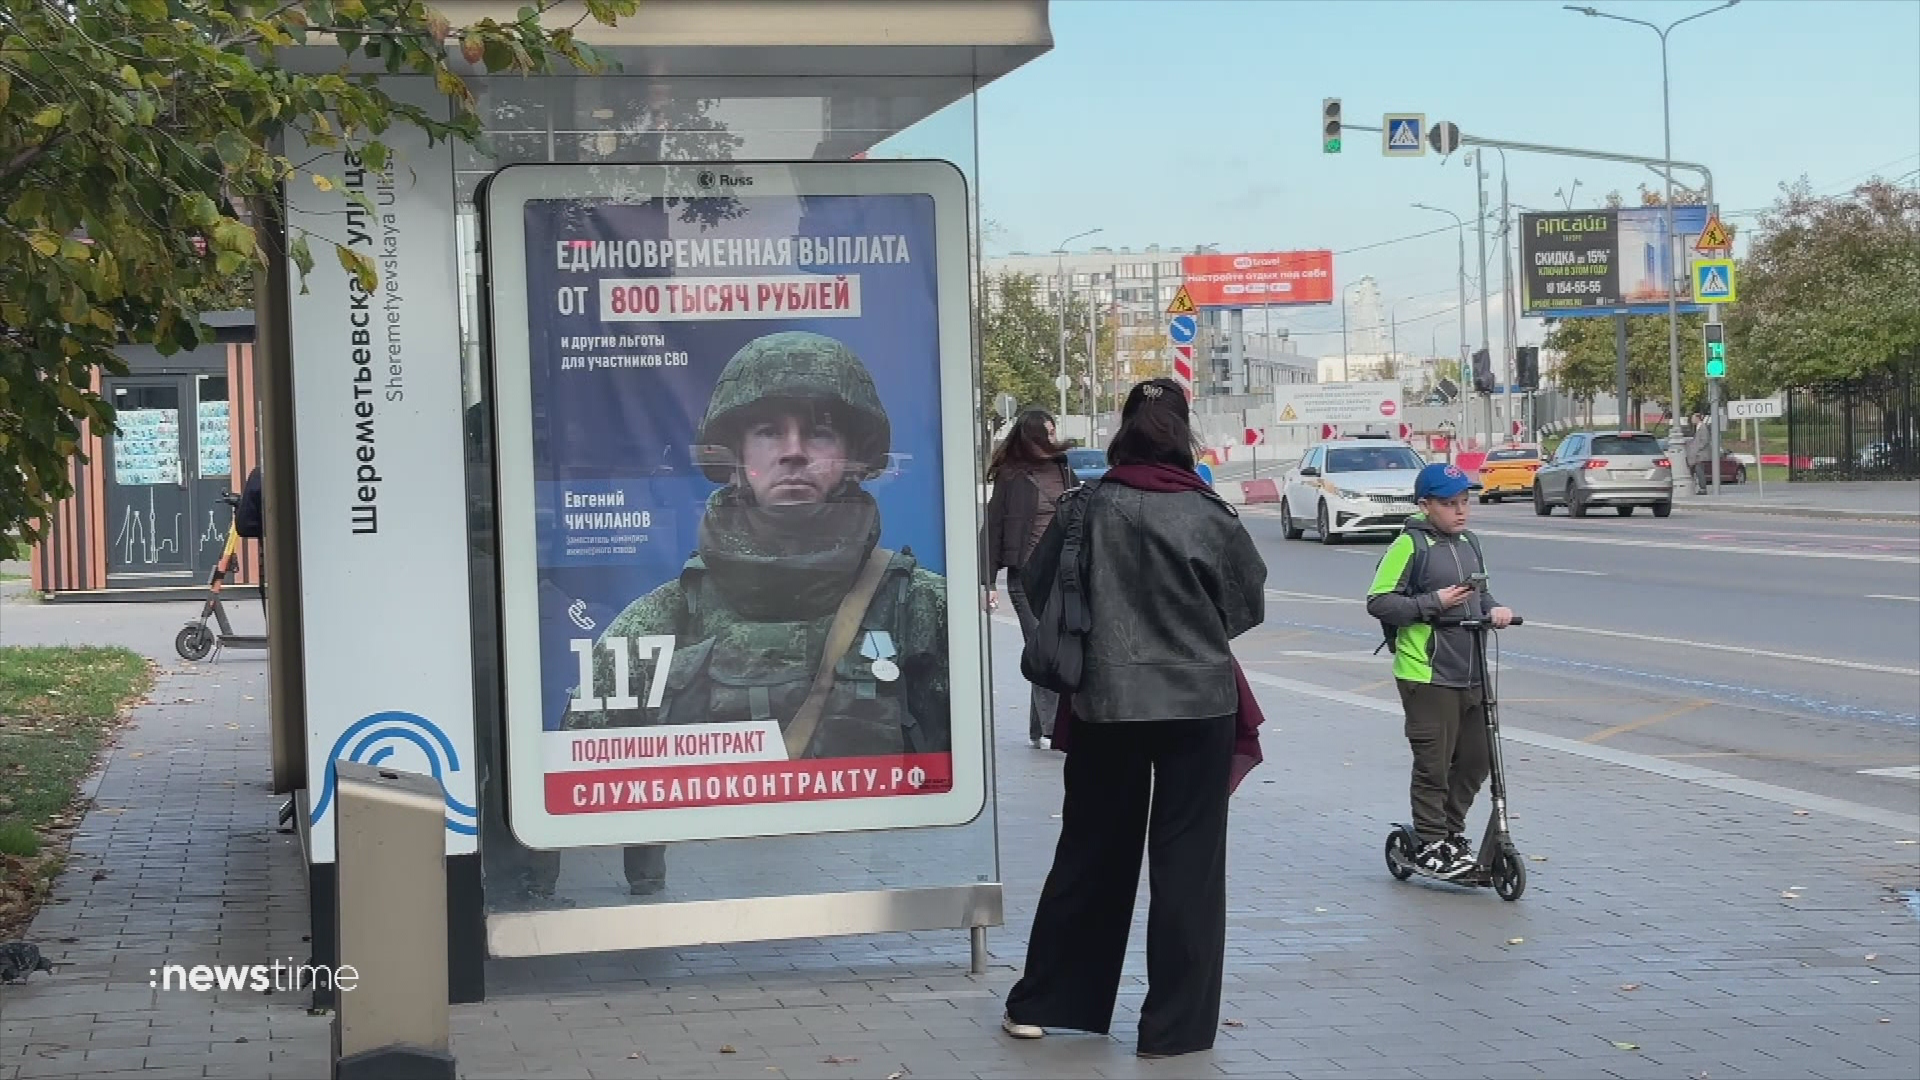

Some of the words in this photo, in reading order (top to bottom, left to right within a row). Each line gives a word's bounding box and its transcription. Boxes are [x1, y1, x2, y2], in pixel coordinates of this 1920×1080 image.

[720, 174, 753, 186] Russ
[556, 238, 792, 272] ЕДИНОВРЕМЕННАЯ
[799, 235, 910, 266] ВЫПЛАТА
[1535, 250, 1575, 266] СКИДКА
[1246, 272, 1278, 281] отдых
[1302, 269, 1327, 278] себя
[1571, 265, 1589, 275] ЭТОМ
[1590, 264, 1608, 274] ГОДУ
[557, 286, 589, 316] ОТ
[611, 286, 660, 314] 800
[665, 284, 749, 314] ТЫСЯЧ
[757, 275, 850, 312] РУБЛЕЙ
[378, 214, 404, 402] Sheremetyevskaya
[561, 336, 569, 348] и
[571, 336, 616, 352] другие
[619, 334, 665, 348] льготы
[561, 356, 586, 370] для
[587, 355, 662, 371] участников
[664, 352, 688, 366] СВО
[350, 262, 382, 535] Шереметьевска
[1736, 402, 1773, 416] СТОП
[564, 489, 625, 508] Евгений
[565, 511, 651, 530] ЧИЧИЛАНОВ
[569, 634, 675, 712] 117
[572, 736, 668, 763] ПОДПИШИ
[674, 730, 765, 757] КОНТРАКТ
[573, 766, 926, 806] СЛУЖБАПОКОНТРАКТУ.РФ
